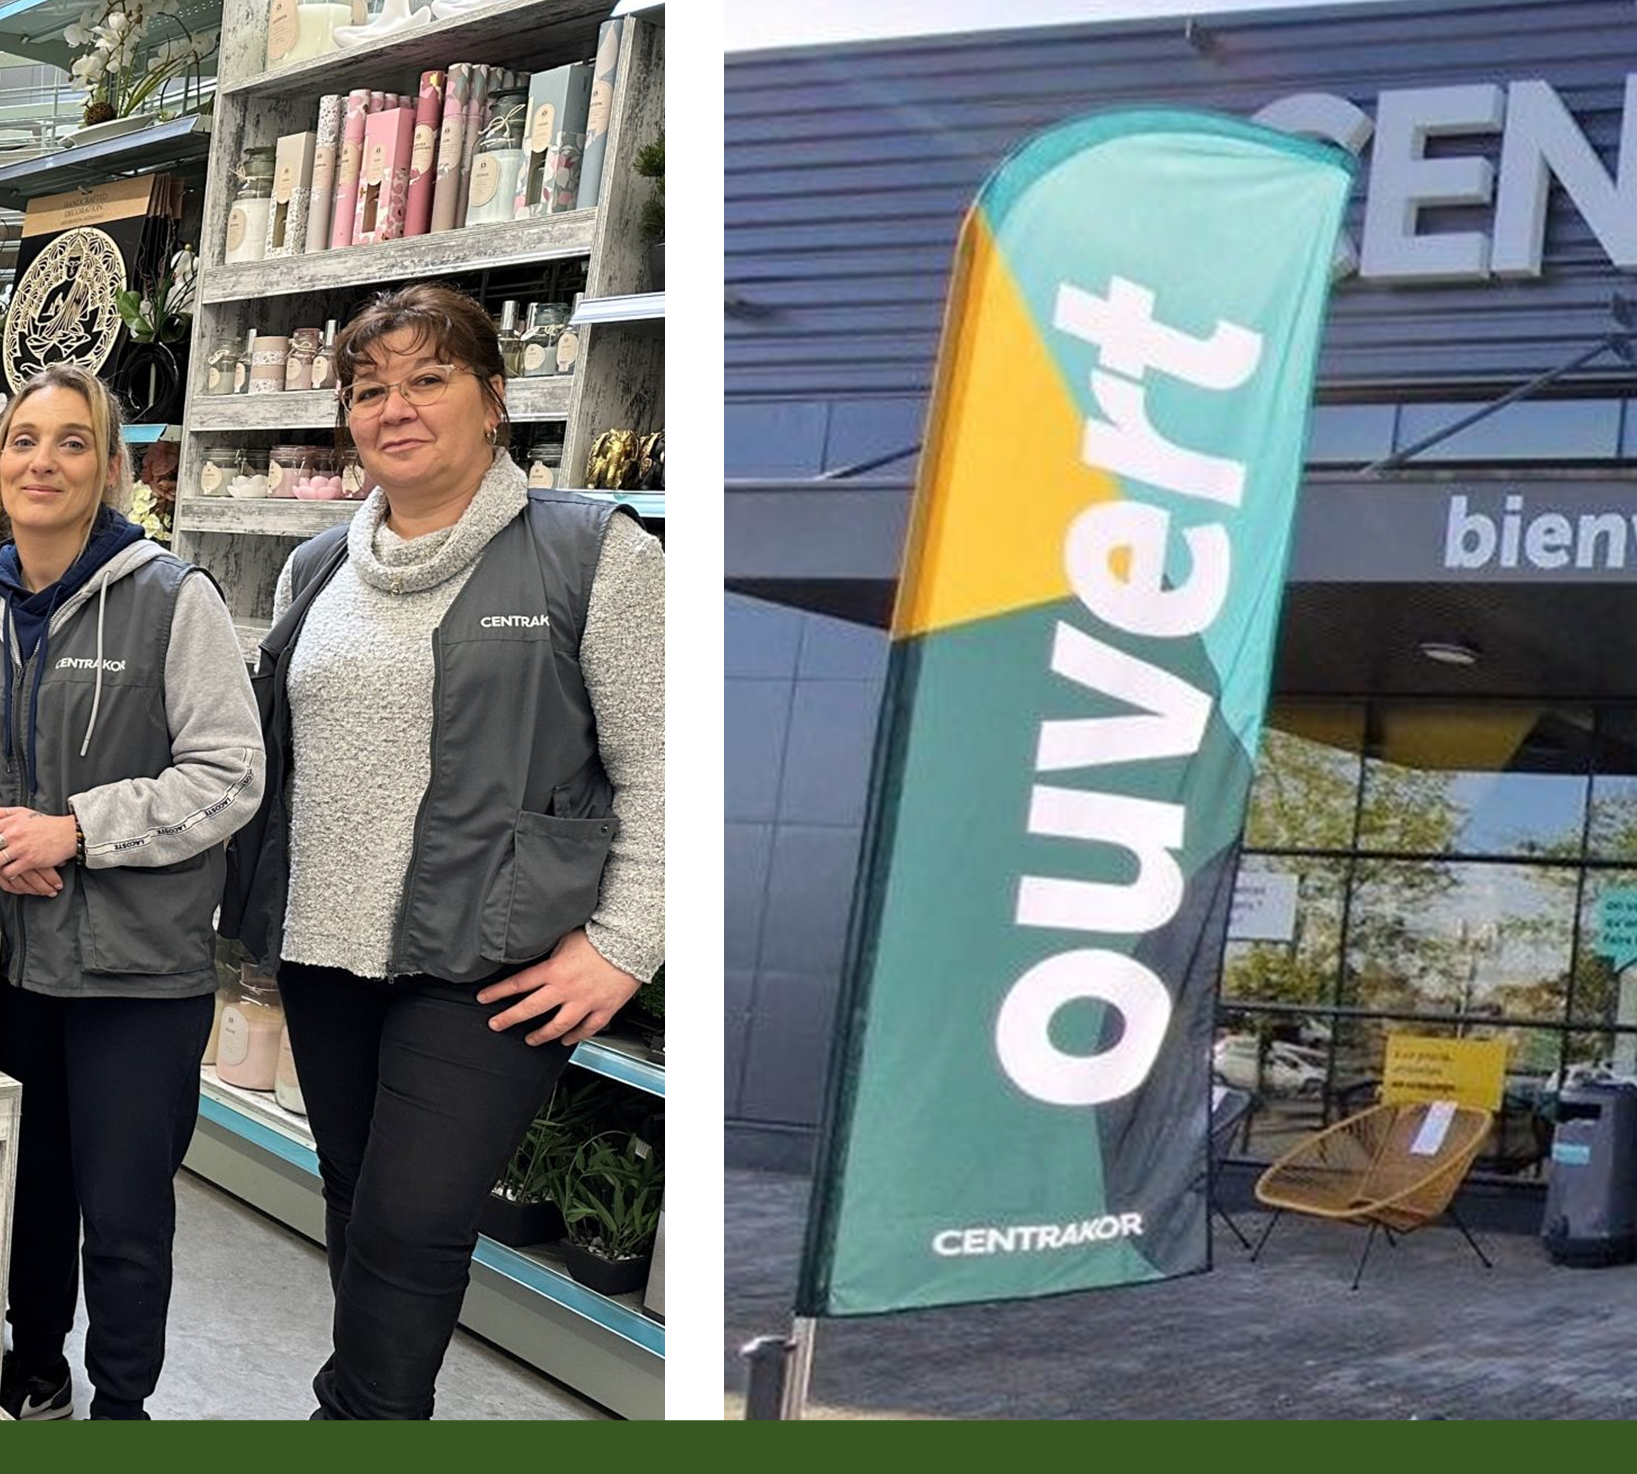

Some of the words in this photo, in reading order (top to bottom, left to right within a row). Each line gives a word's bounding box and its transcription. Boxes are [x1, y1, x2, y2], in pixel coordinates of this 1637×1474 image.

[996, 275, 1263, 1106] ouvert
[114, 839, 145, 851] LACOSTE
[932, 1212, 1144, 1256] CENTRAKOR
